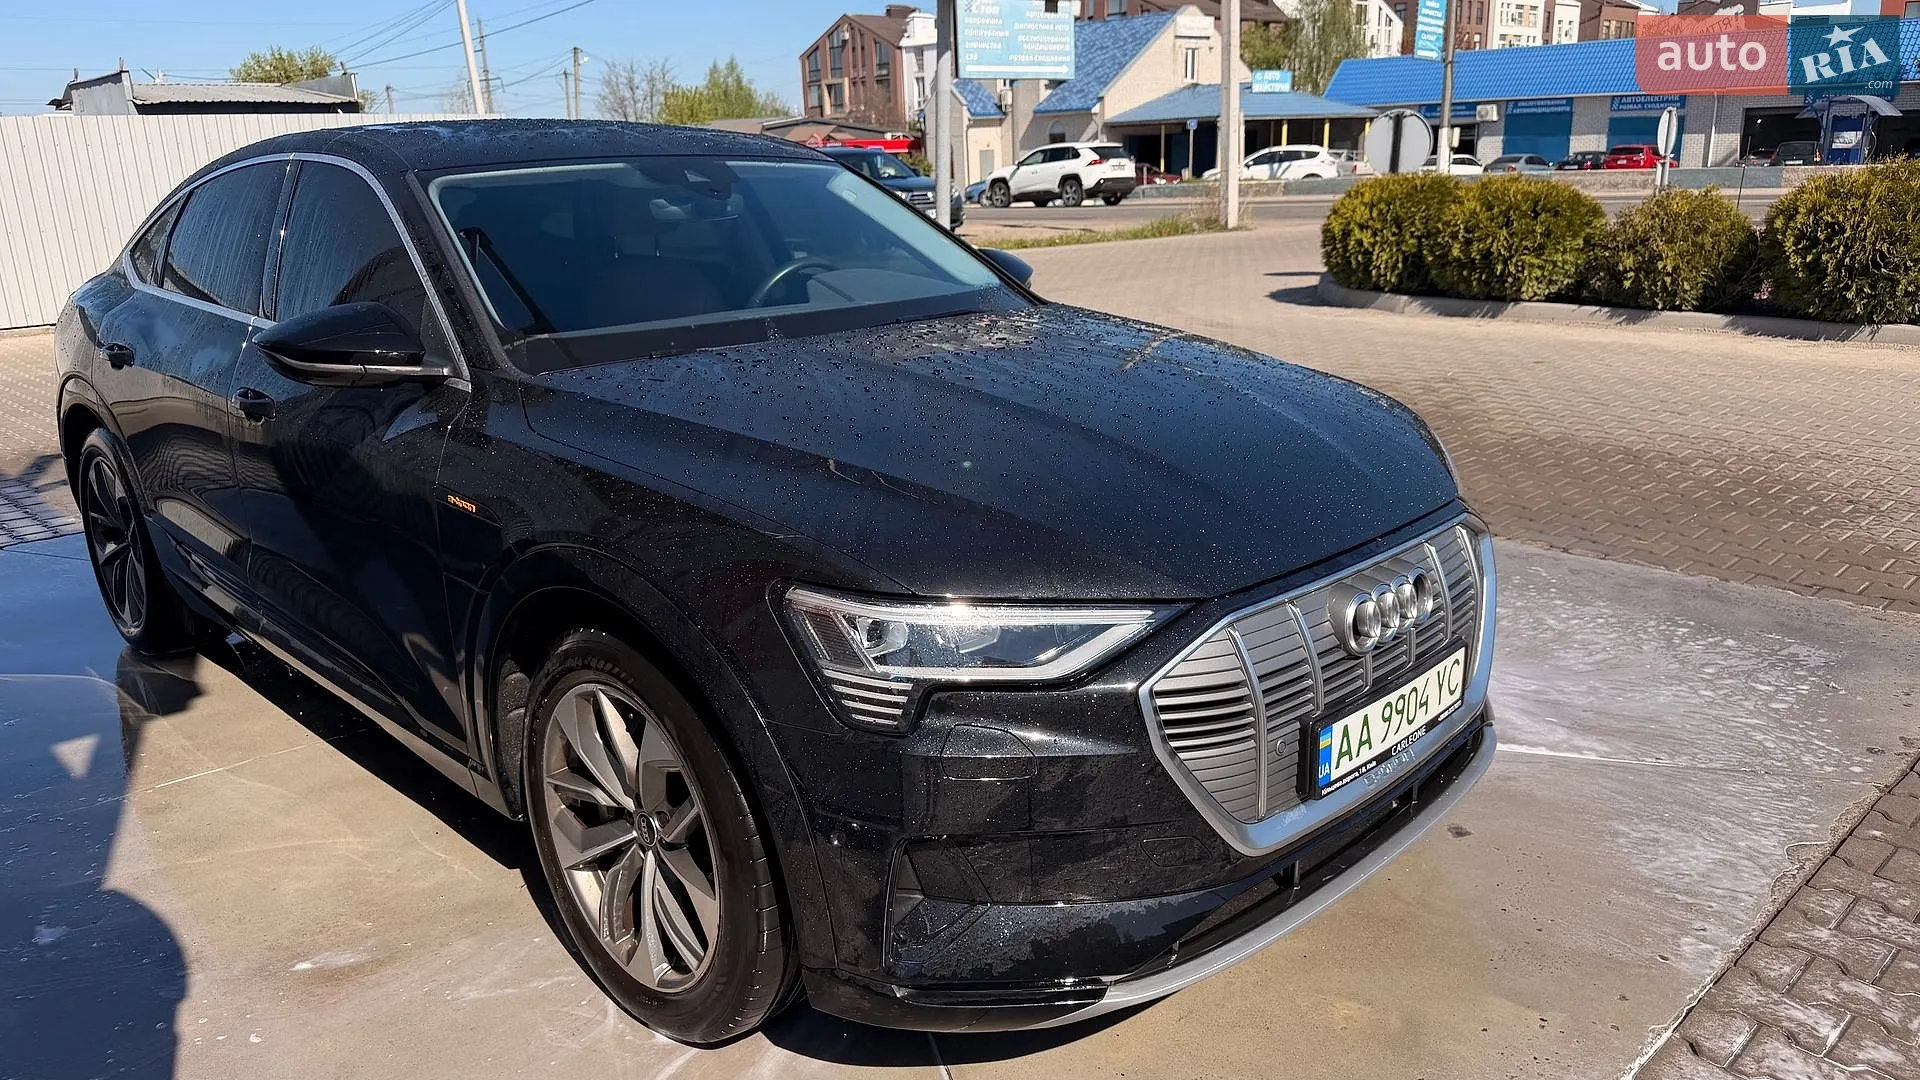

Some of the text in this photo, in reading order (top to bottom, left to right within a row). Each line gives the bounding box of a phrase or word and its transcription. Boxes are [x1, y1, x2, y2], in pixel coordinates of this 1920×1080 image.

[1335, 713, 1373, 770] AA
[1380, 677, 1430, 744] 9904
[1391, 725, 1427, 756] CARLEONE
[1318, 762, 1330, 779] UA
